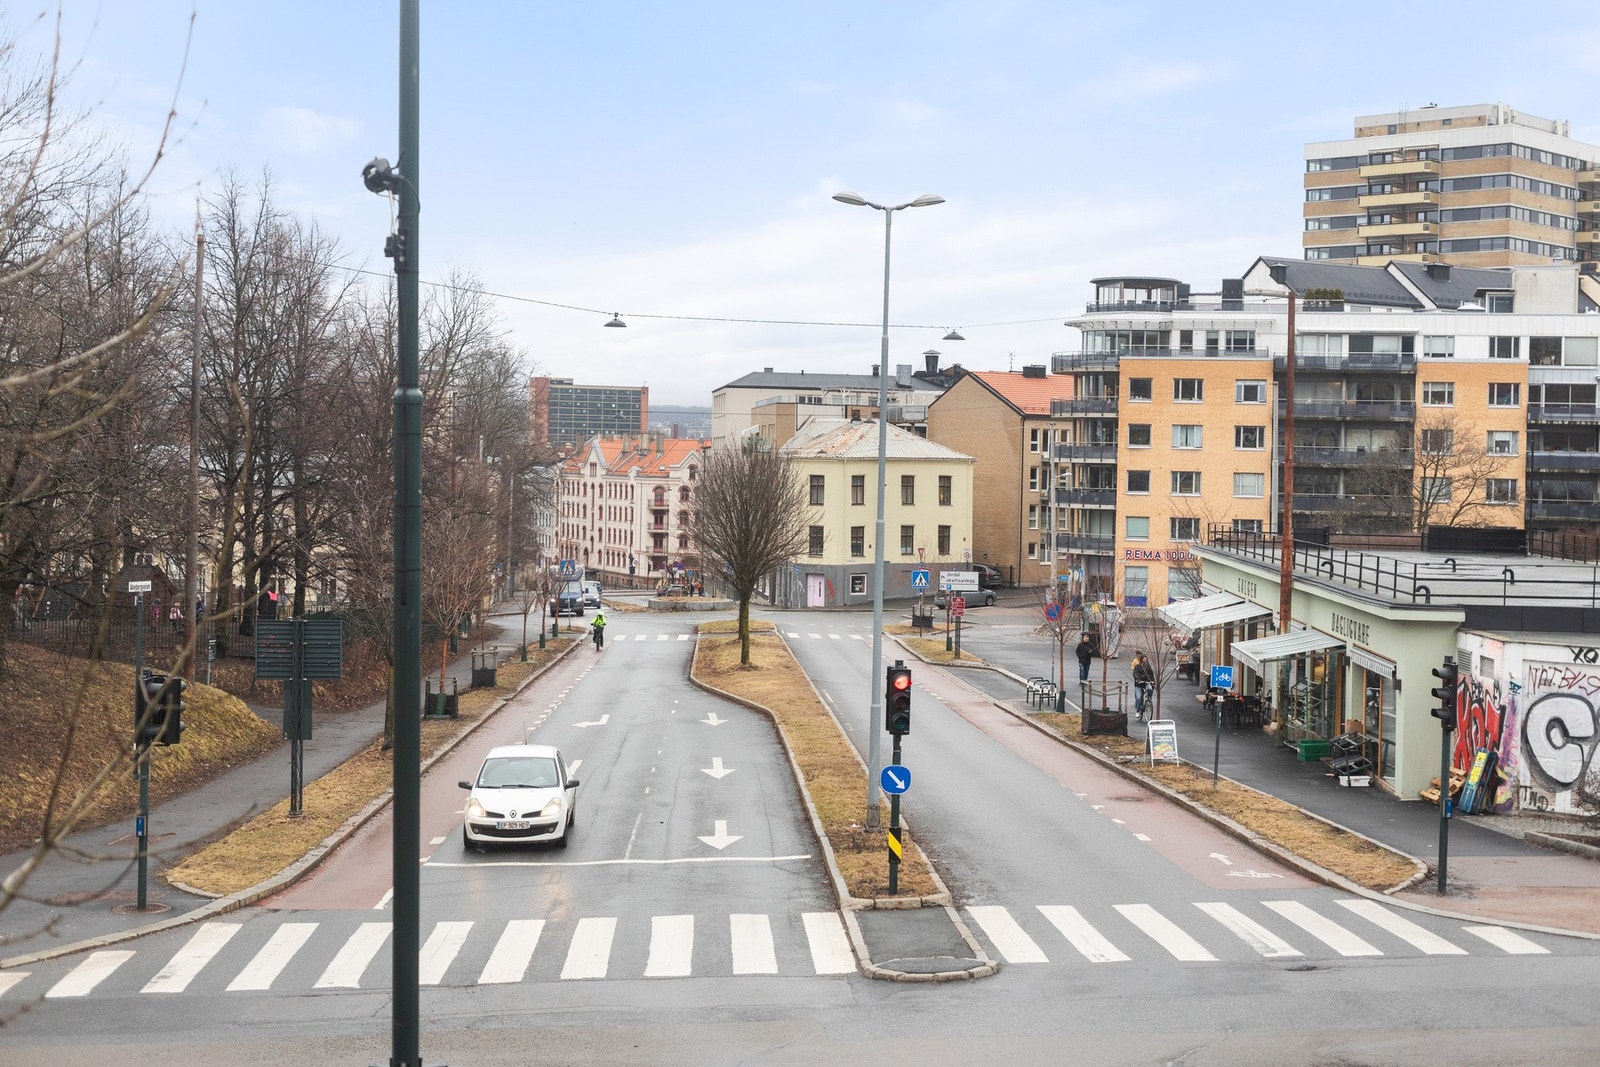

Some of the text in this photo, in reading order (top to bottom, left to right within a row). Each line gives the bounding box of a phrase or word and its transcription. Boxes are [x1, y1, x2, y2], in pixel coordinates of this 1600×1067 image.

[1125, 549, 1193, 560] REMA 1000
[1331, 612, 1370, 646] DAGLIGVARE
